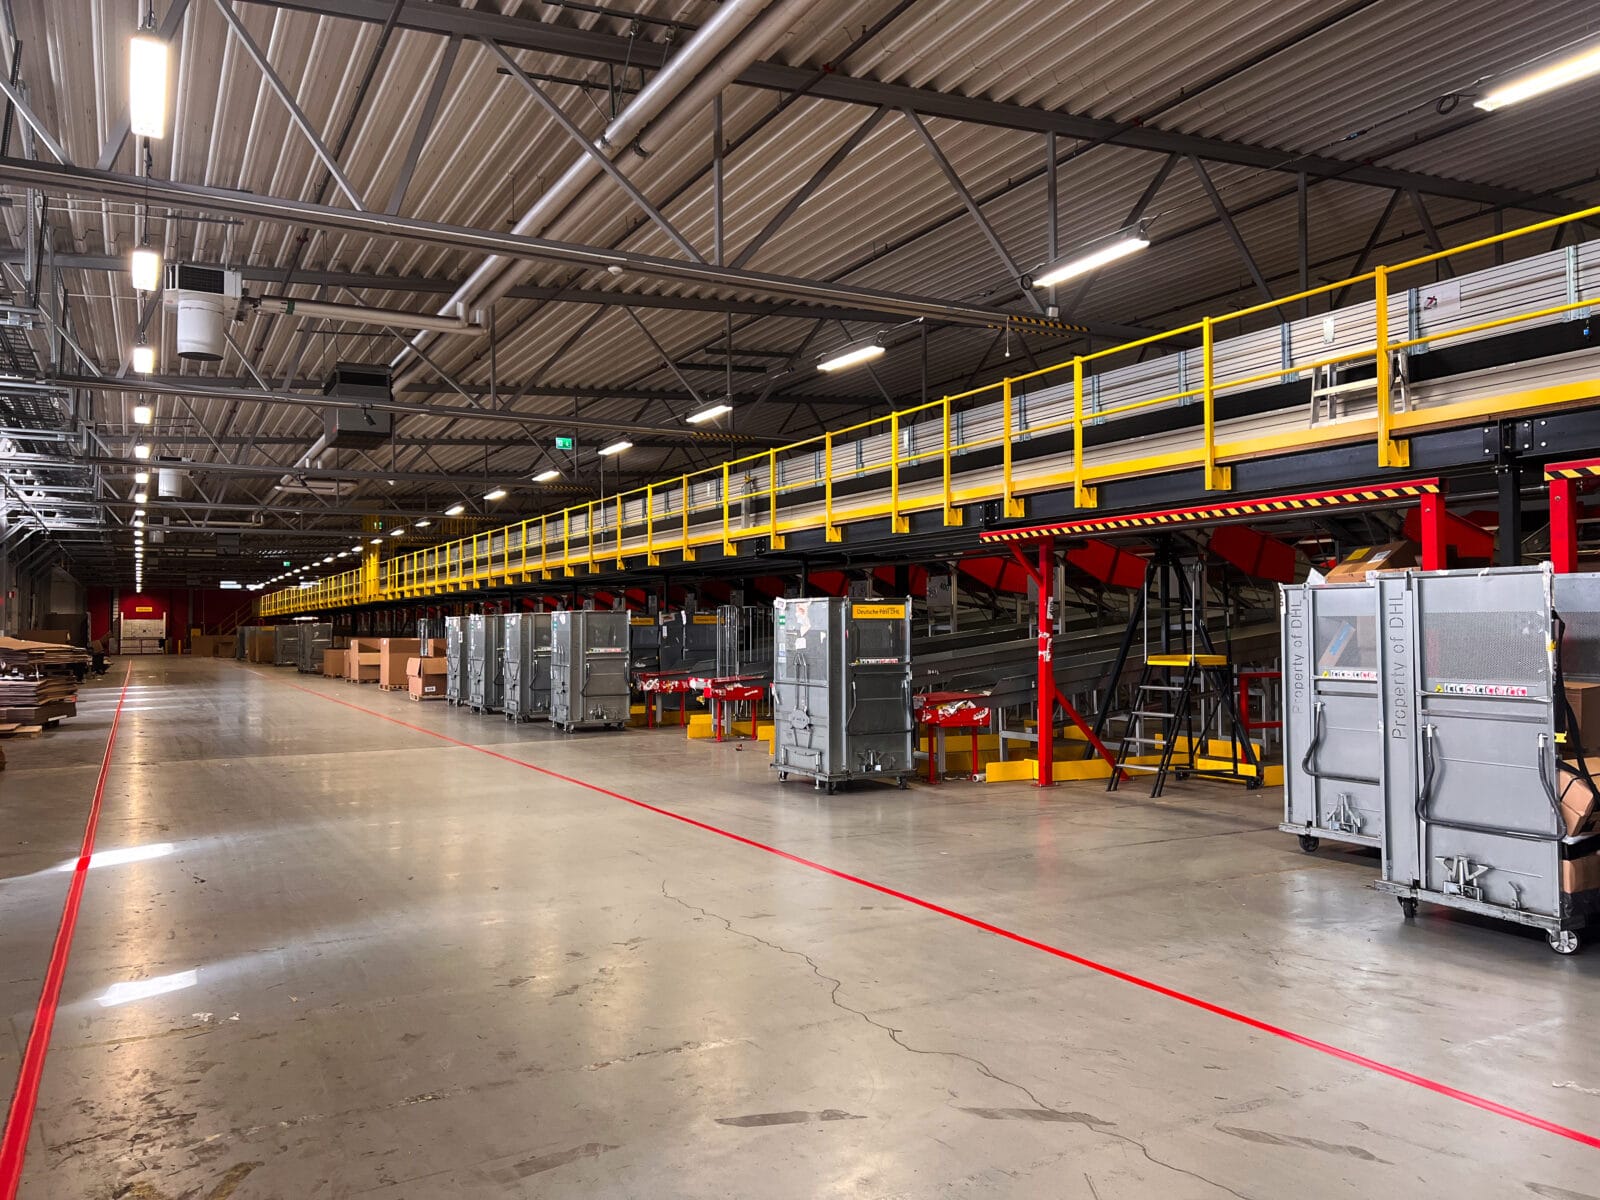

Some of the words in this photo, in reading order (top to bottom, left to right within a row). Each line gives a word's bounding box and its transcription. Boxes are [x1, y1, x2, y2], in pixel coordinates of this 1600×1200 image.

[1290, 601, 1302, 629] DHL
[1388, 591, 1404, 629] DHL
[1291, 634, 1303, 648] of
[1389, 636, 1405, 654] of
[1292, 655, 1305, 713] Property
[1391, 660, 1407, 740] Property
